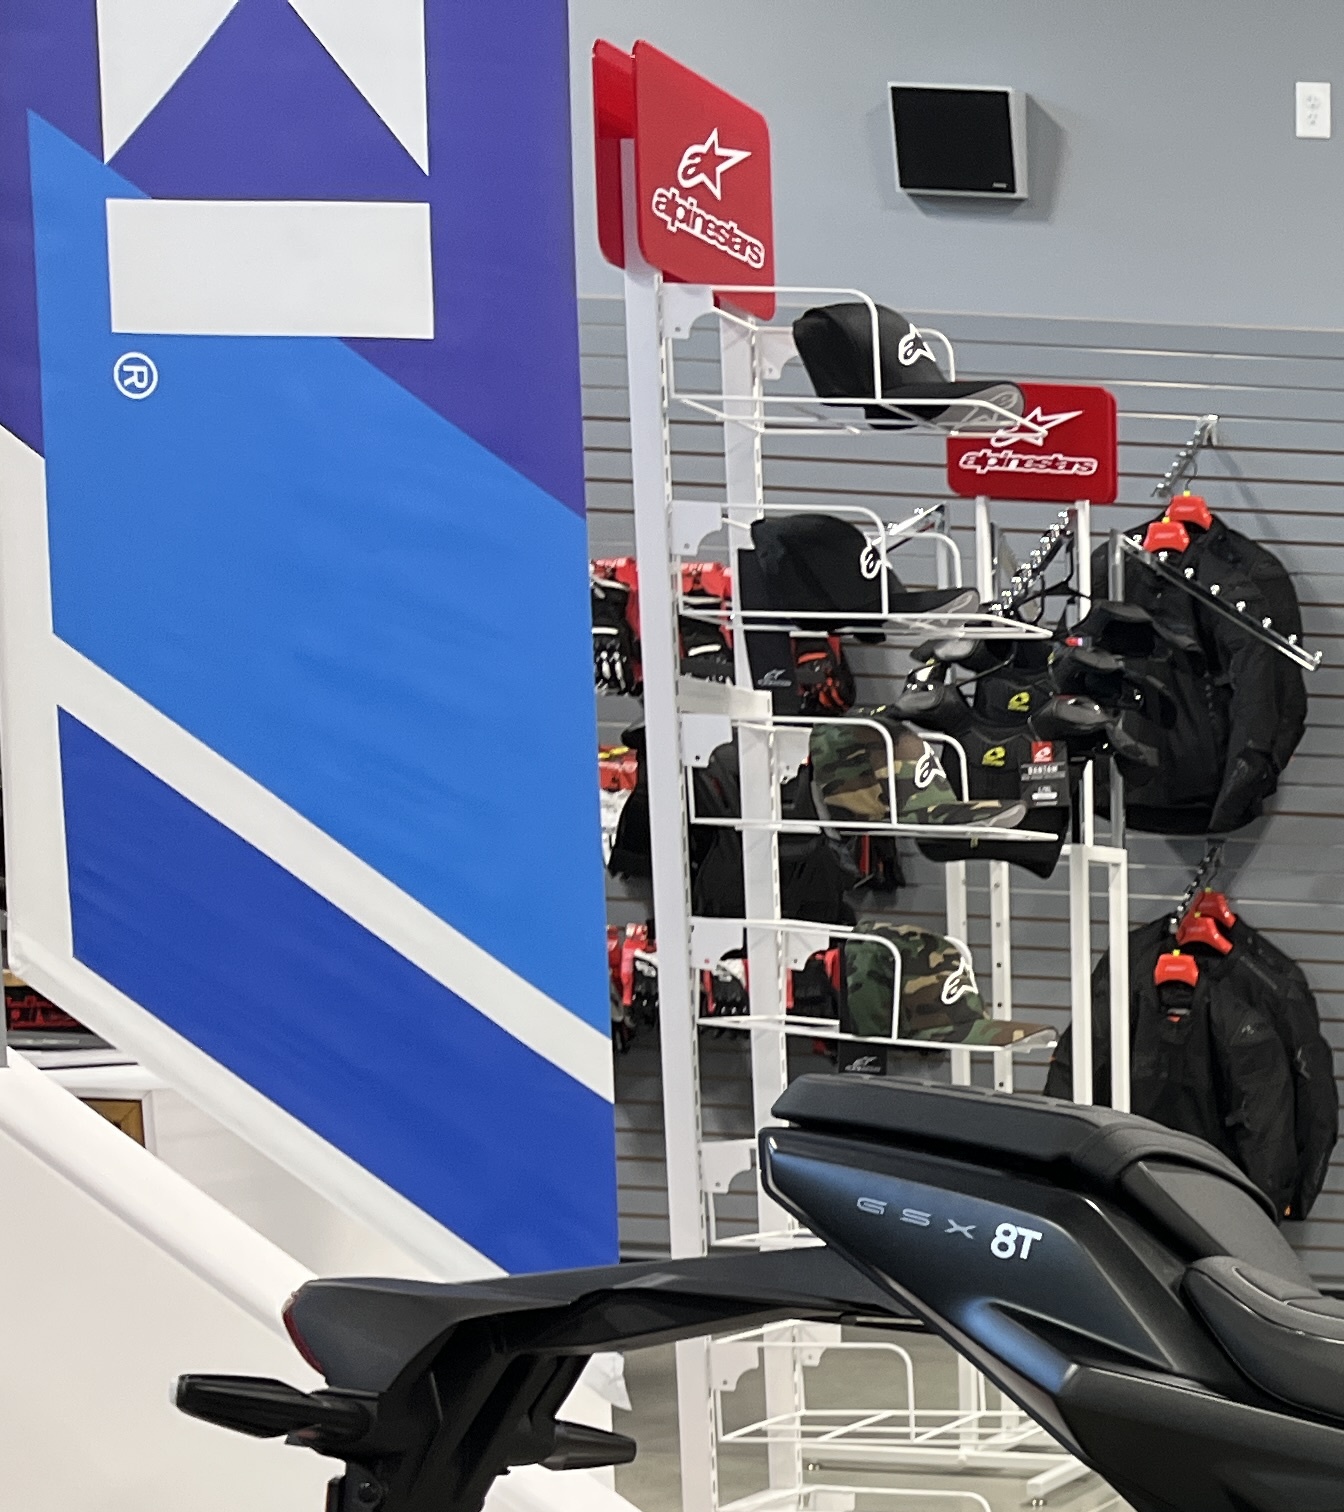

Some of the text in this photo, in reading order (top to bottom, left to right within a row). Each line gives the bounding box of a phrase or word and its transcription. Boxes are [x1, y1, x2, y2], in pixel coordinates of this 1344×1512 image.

[652, 187, 765, 269] alpinestars
[959, 449, 1098, 476] alpinestars
[990, 1222, 1043, 1260] 8T
